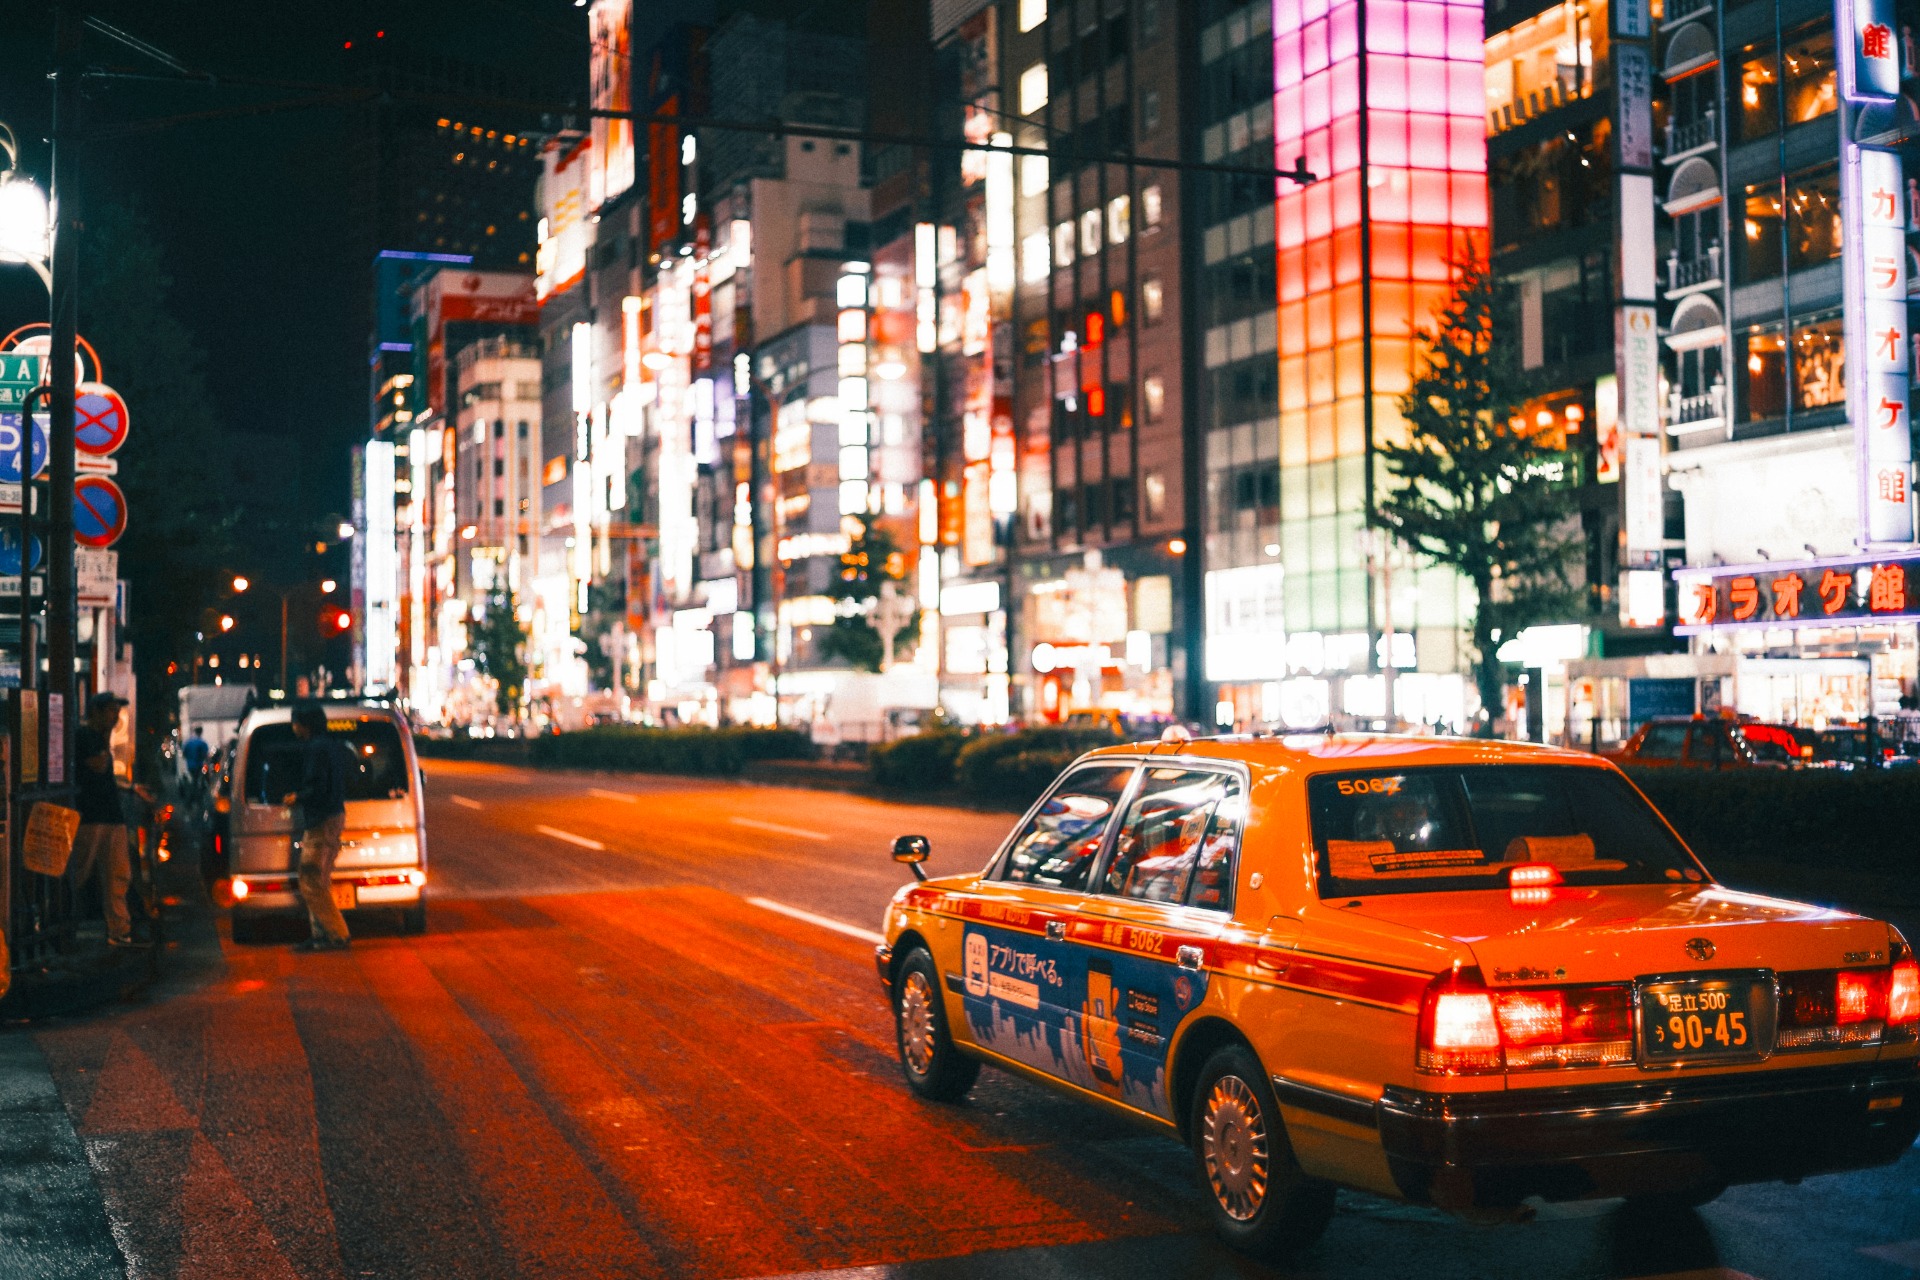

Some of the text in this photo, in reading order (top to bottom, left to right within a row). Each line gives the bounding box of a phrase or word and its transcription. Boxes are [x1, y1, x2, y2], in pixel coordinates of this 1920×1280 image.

[1861, 23, 1890, 60] 館
[1872, 186, 1905, 503] カラオケ館
[1693, 563, 1905, 624] カラオケ館
[1129, 929, 1164, 954] 5062
[1669, 1012, 1748, 1050] 90-45
